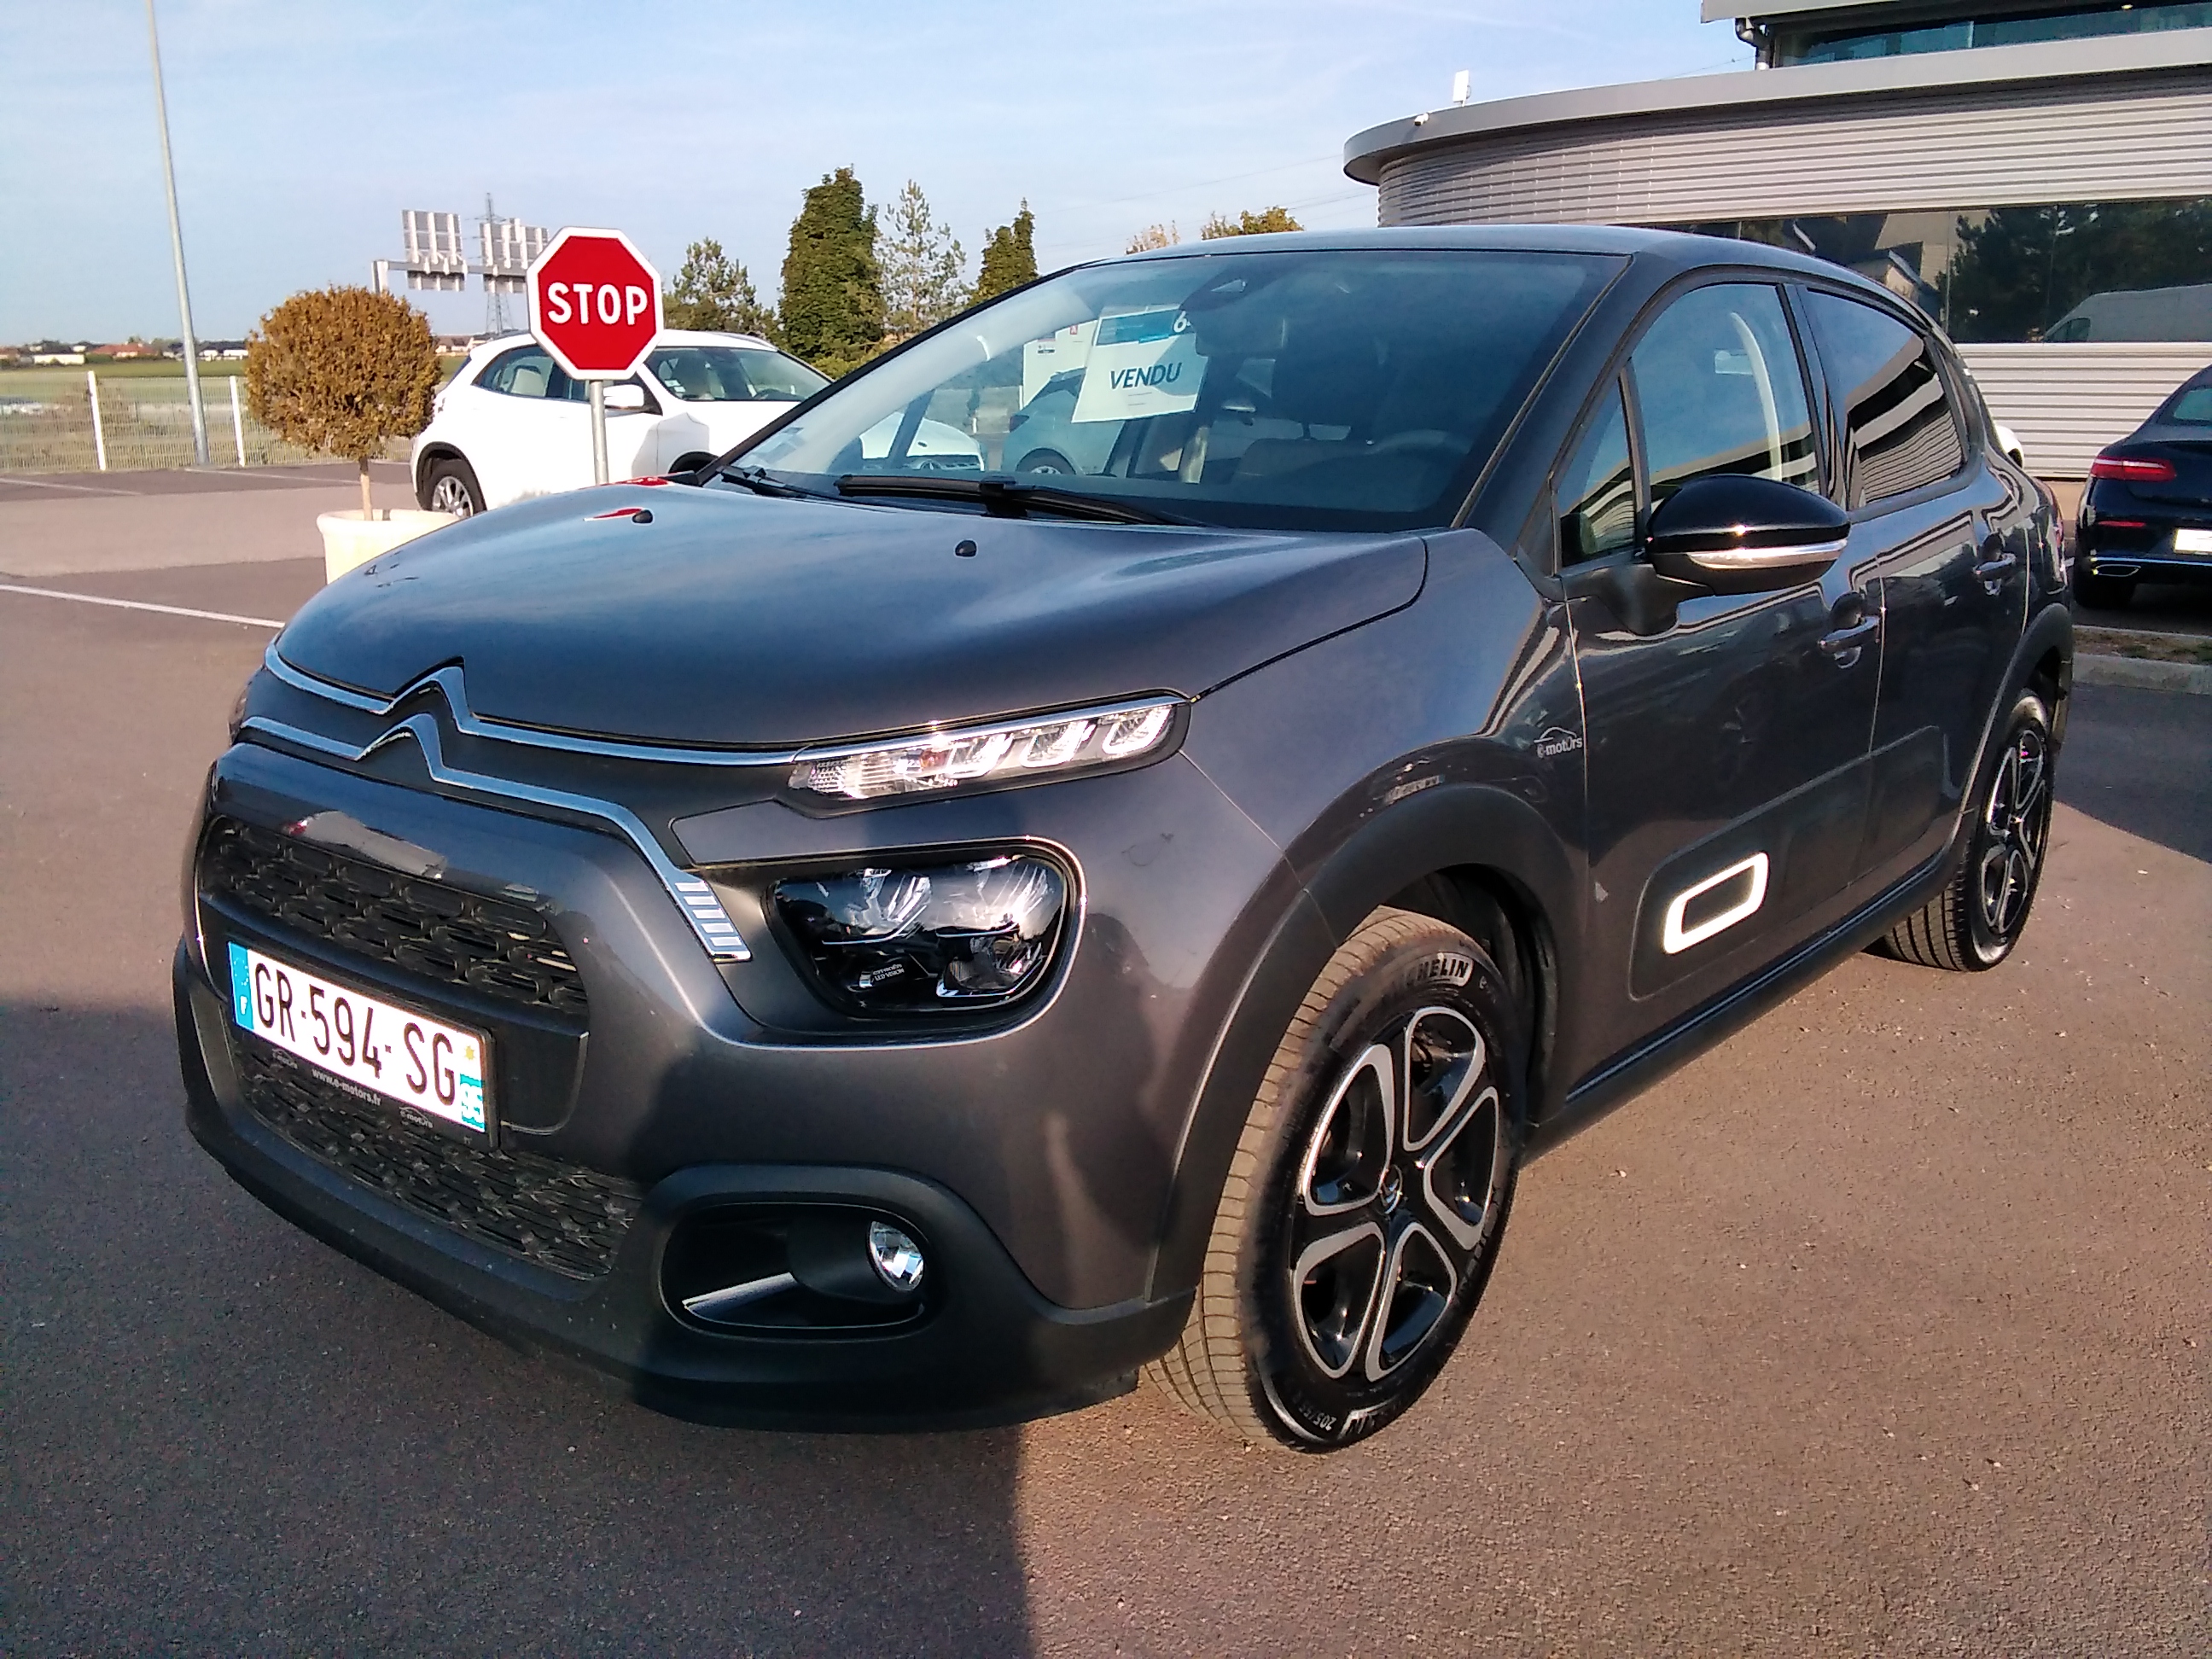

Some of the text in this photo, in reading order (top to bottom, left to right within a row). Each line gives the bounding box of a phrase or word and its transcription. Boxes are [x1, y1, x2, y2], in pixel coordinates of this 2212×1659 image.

[548, 282, 648, 325] STOP
[1110, 362, 1183, 390] VENDU
[311, 1068, 381, 1107] www.e-motors.fr
